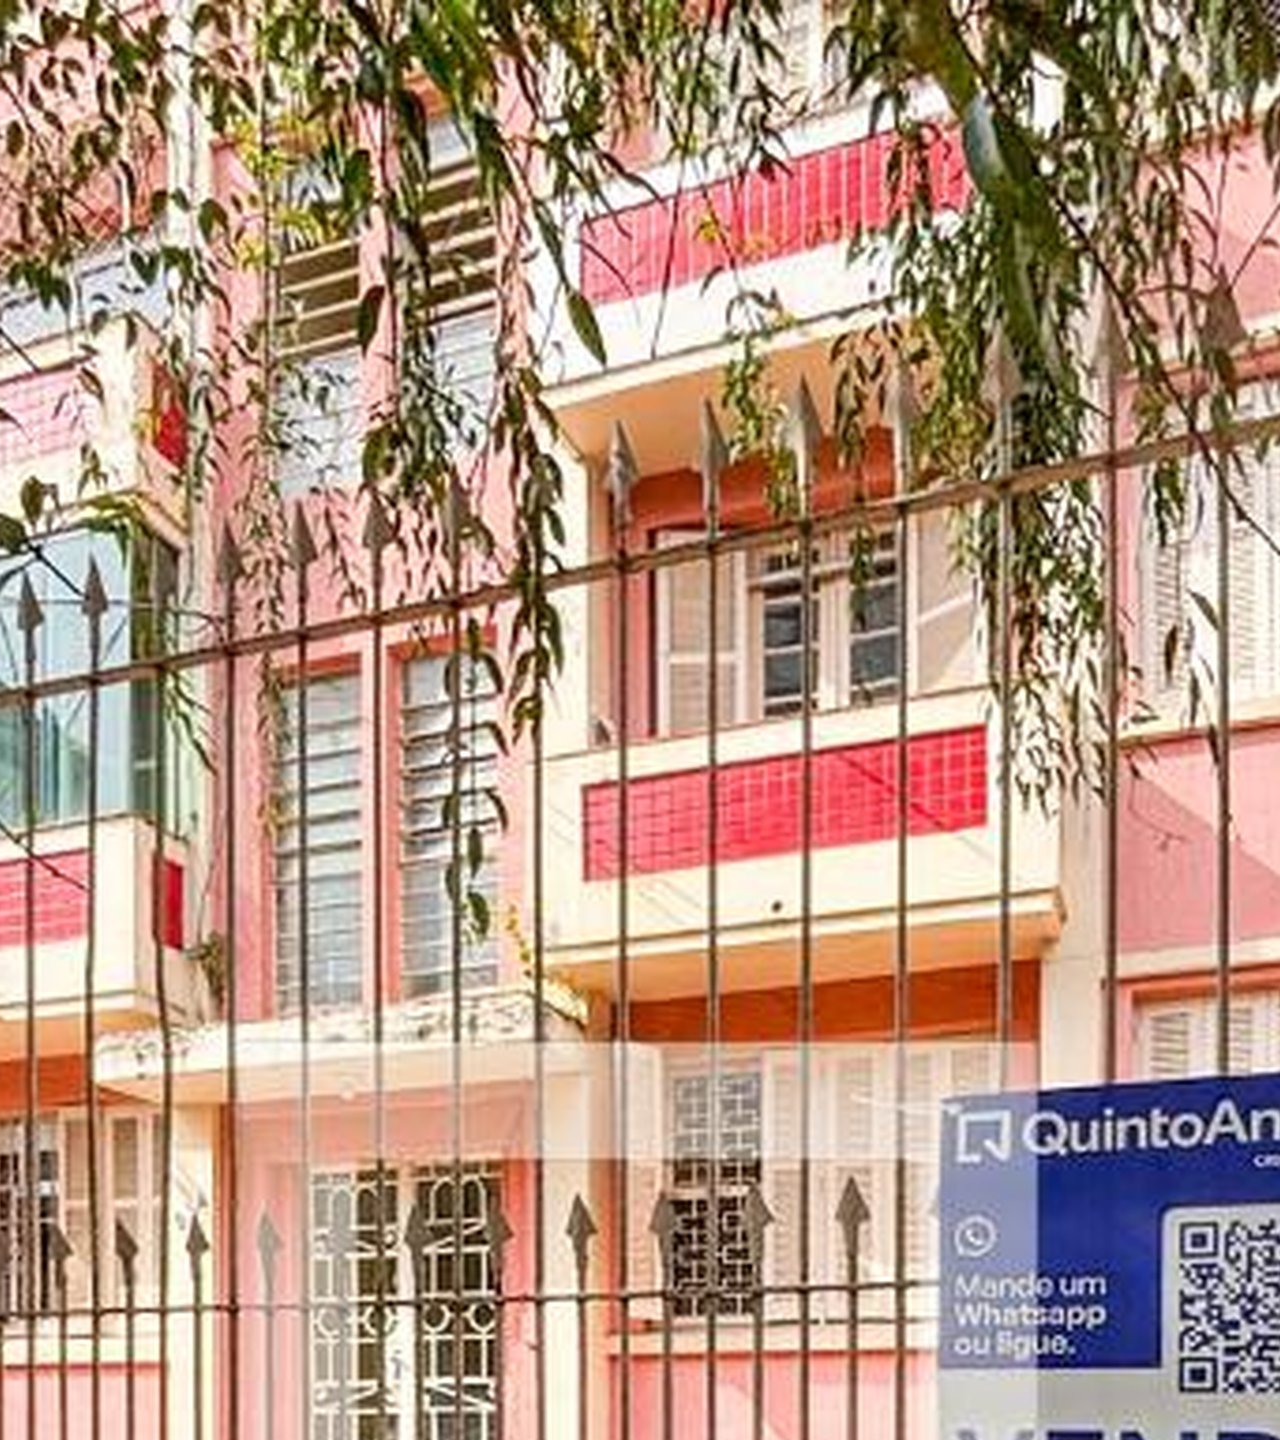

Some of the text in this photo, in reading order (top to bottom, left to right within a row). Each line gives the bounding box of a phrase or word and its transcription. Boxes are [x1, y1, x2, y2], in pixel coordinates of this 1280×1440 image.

[954, 1273, 1107, 1298] Mande um
[954, 1303, 1107, 1331] Whatsapp
[954, 1331, 1076, 1361] ou ligue.
